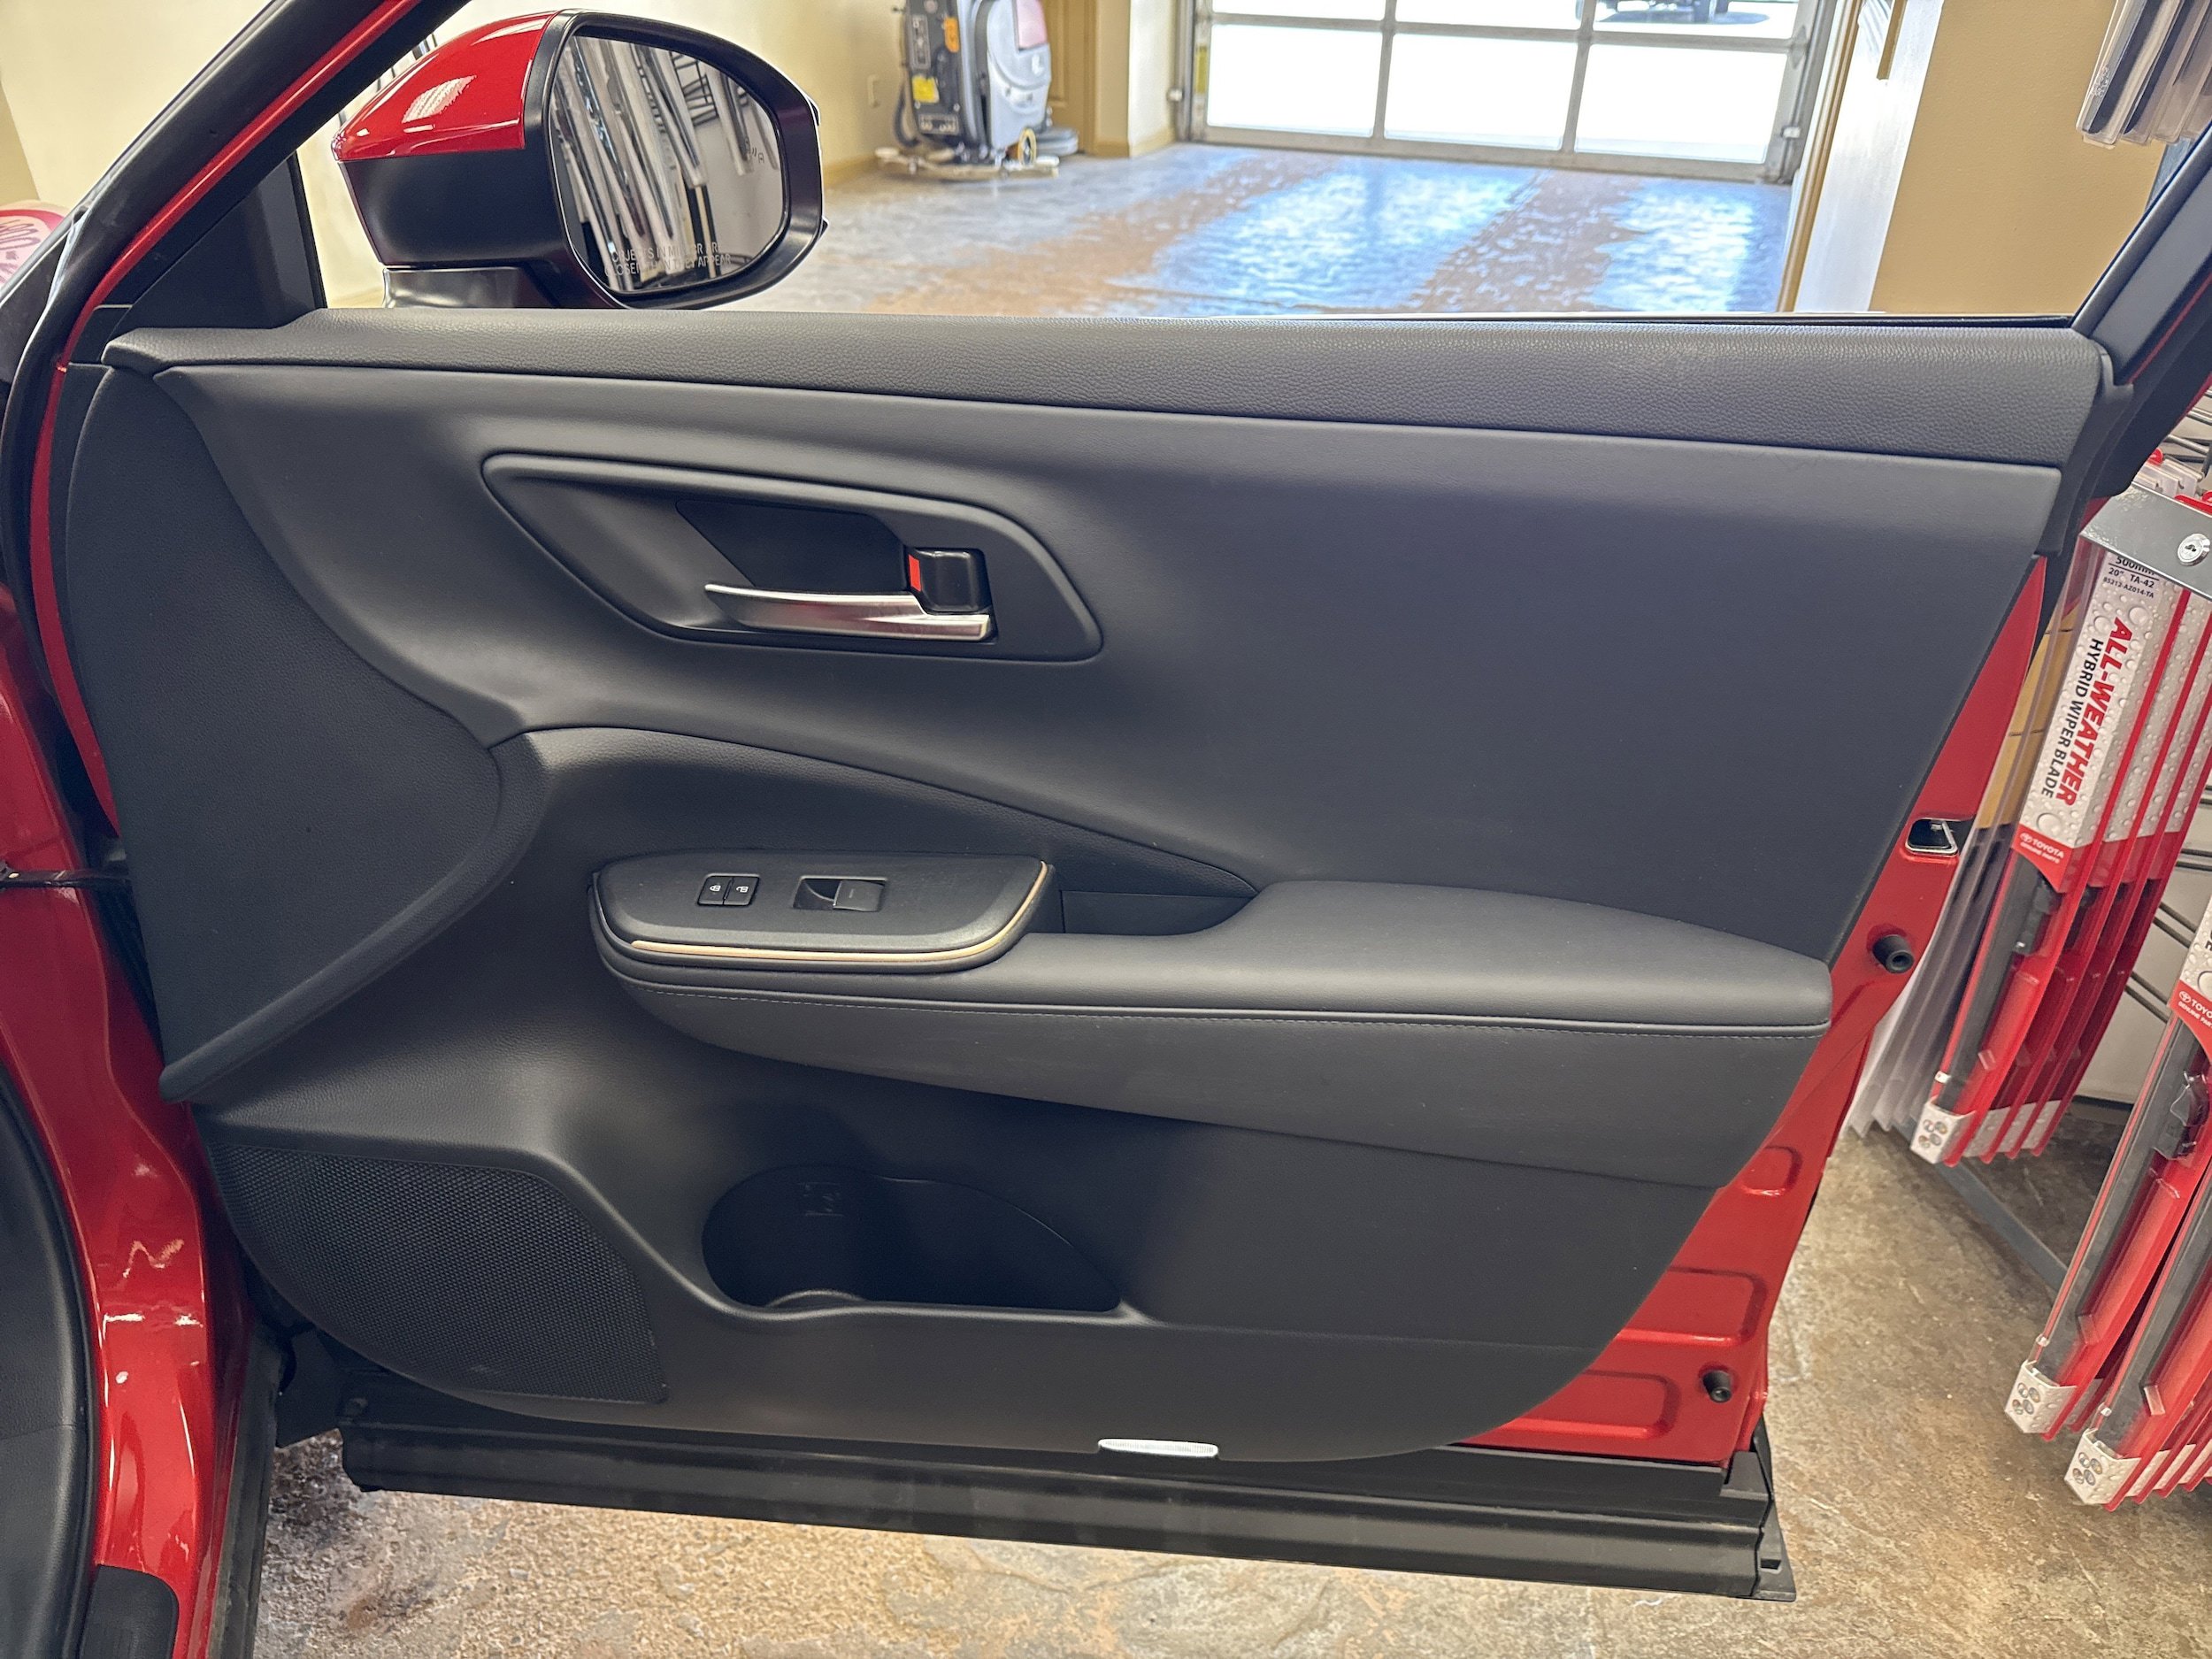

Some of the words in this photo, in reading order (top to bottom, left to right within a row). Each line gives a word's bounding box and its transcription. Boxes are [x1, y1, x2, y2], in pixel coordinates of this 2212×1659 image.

[605, 262, 641, 277] COSER
[697, 253, 731, 268] APPEAR
[611, 247, 655, 263] OBJETS
[668, 243, 704, 256] MIOR
[2131, 574, 2154, 588] TA-42
[2075, 638, 2104, 697] HYBRID
[2055, 616, 2132, 806] ALL-WEATHER
[2057, 700, 2084, 748] WIPER
[2041, 749, 2067, 799] BLADE
[2032, 838, 2064, 859] TOYOTA
